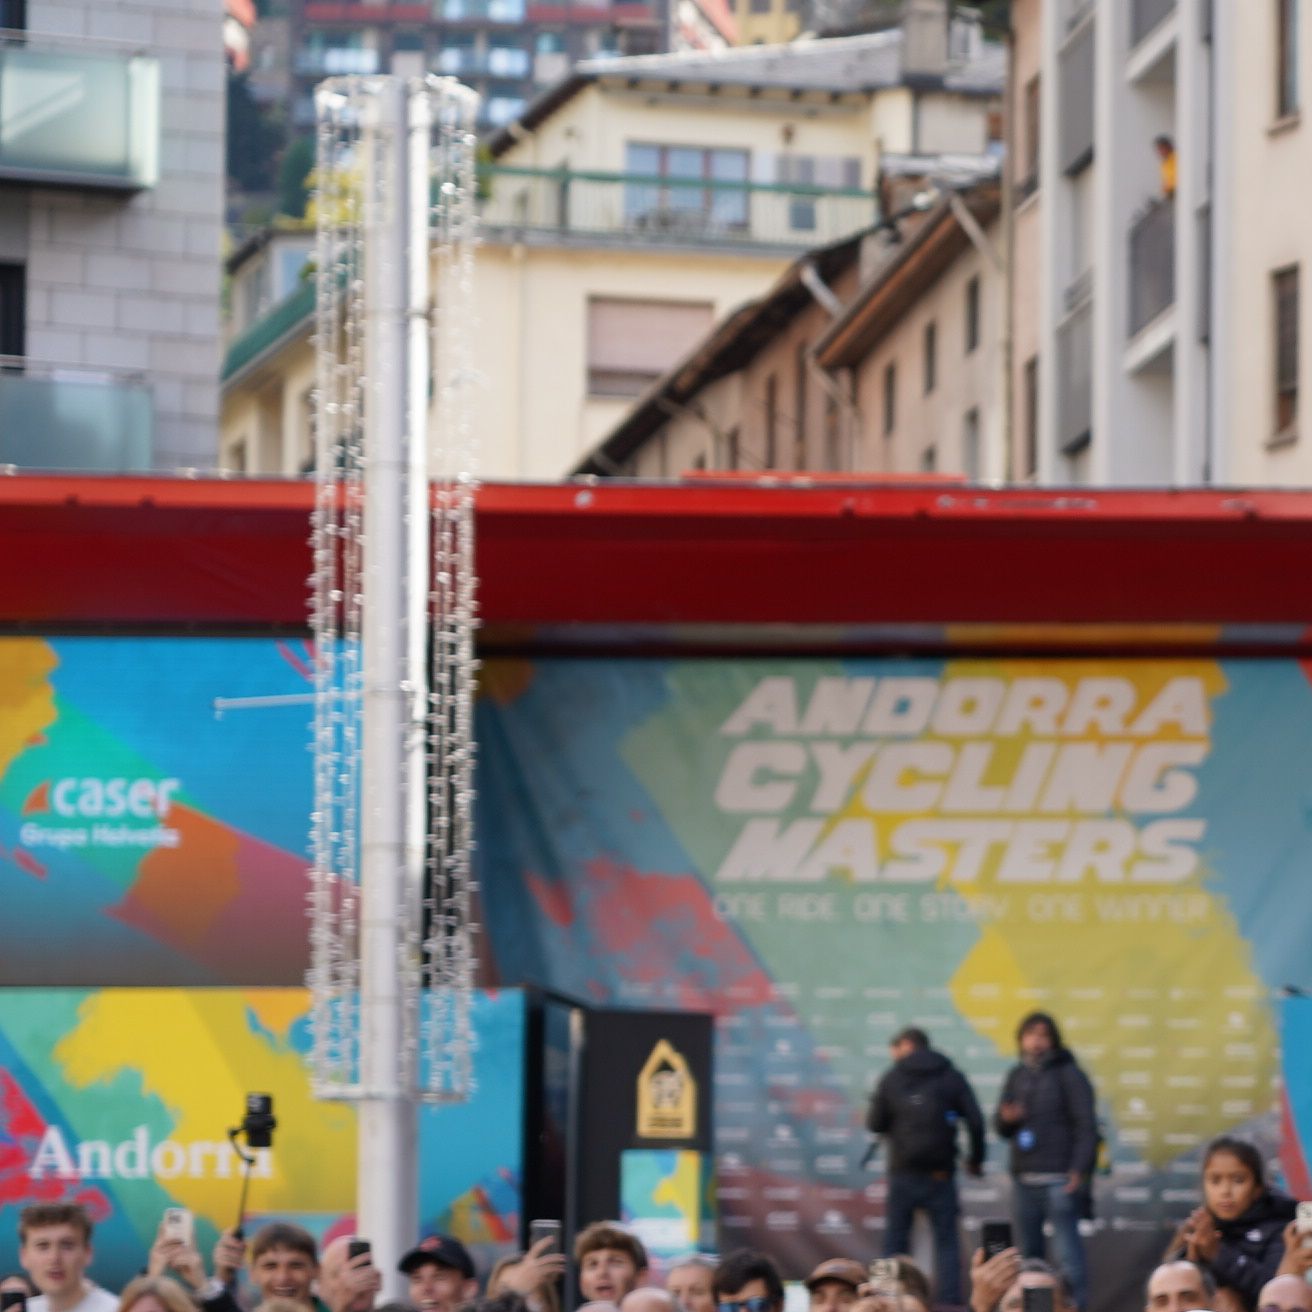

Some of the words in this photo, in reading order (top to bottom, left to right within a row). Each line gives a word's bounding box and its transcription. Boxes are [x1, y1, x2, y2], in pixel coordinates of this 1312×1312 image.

[718, 677, 1208, 737] ANDORRA
[53, 777, 181, 818] caser
[714, 741, 1210, 814] CYCLING
[715, 818, 1207, 883] MASTERS
[28, 1124, 275, 1180] Andorra
